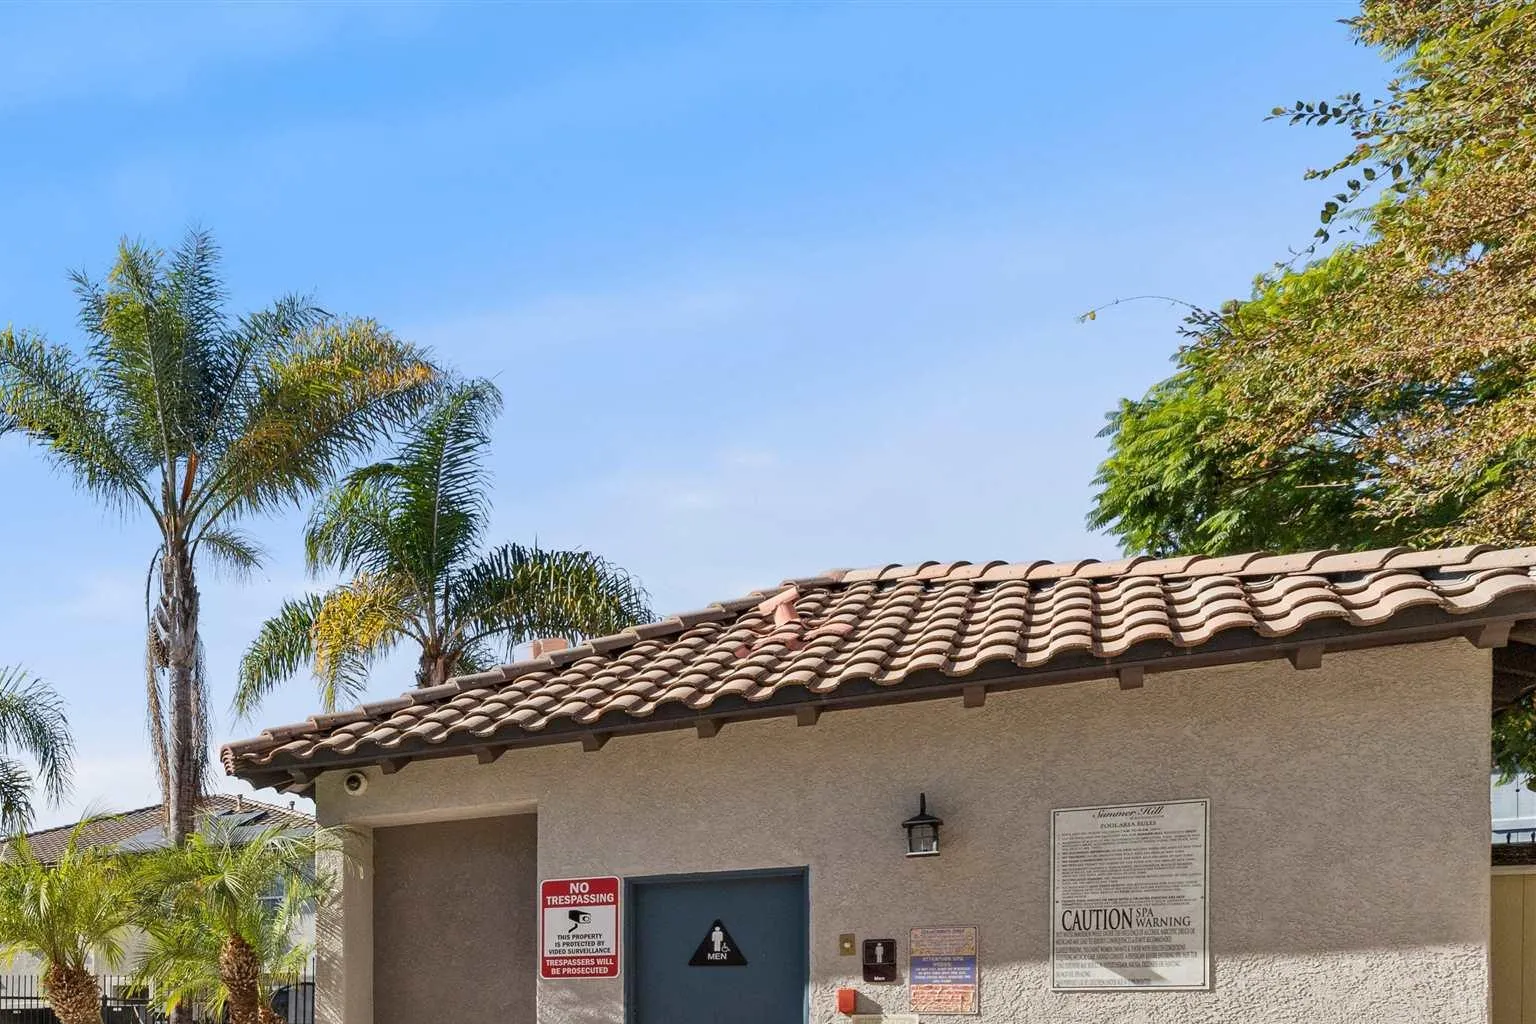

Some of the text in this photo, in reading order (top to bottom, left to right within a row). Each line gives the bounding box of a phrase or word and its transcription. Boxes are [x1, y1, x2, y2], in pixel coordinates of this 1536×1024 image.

[570, 882, 589, 893] NO
[546, 893, 614, 905] TRESPASSING
[1136, 907, 1154, 917] SPA
[1062, 908, 1133, 931] CAUTION
[1136, 916, 1191, 927] WARNING
[707, 952, 727, 960] MEN
